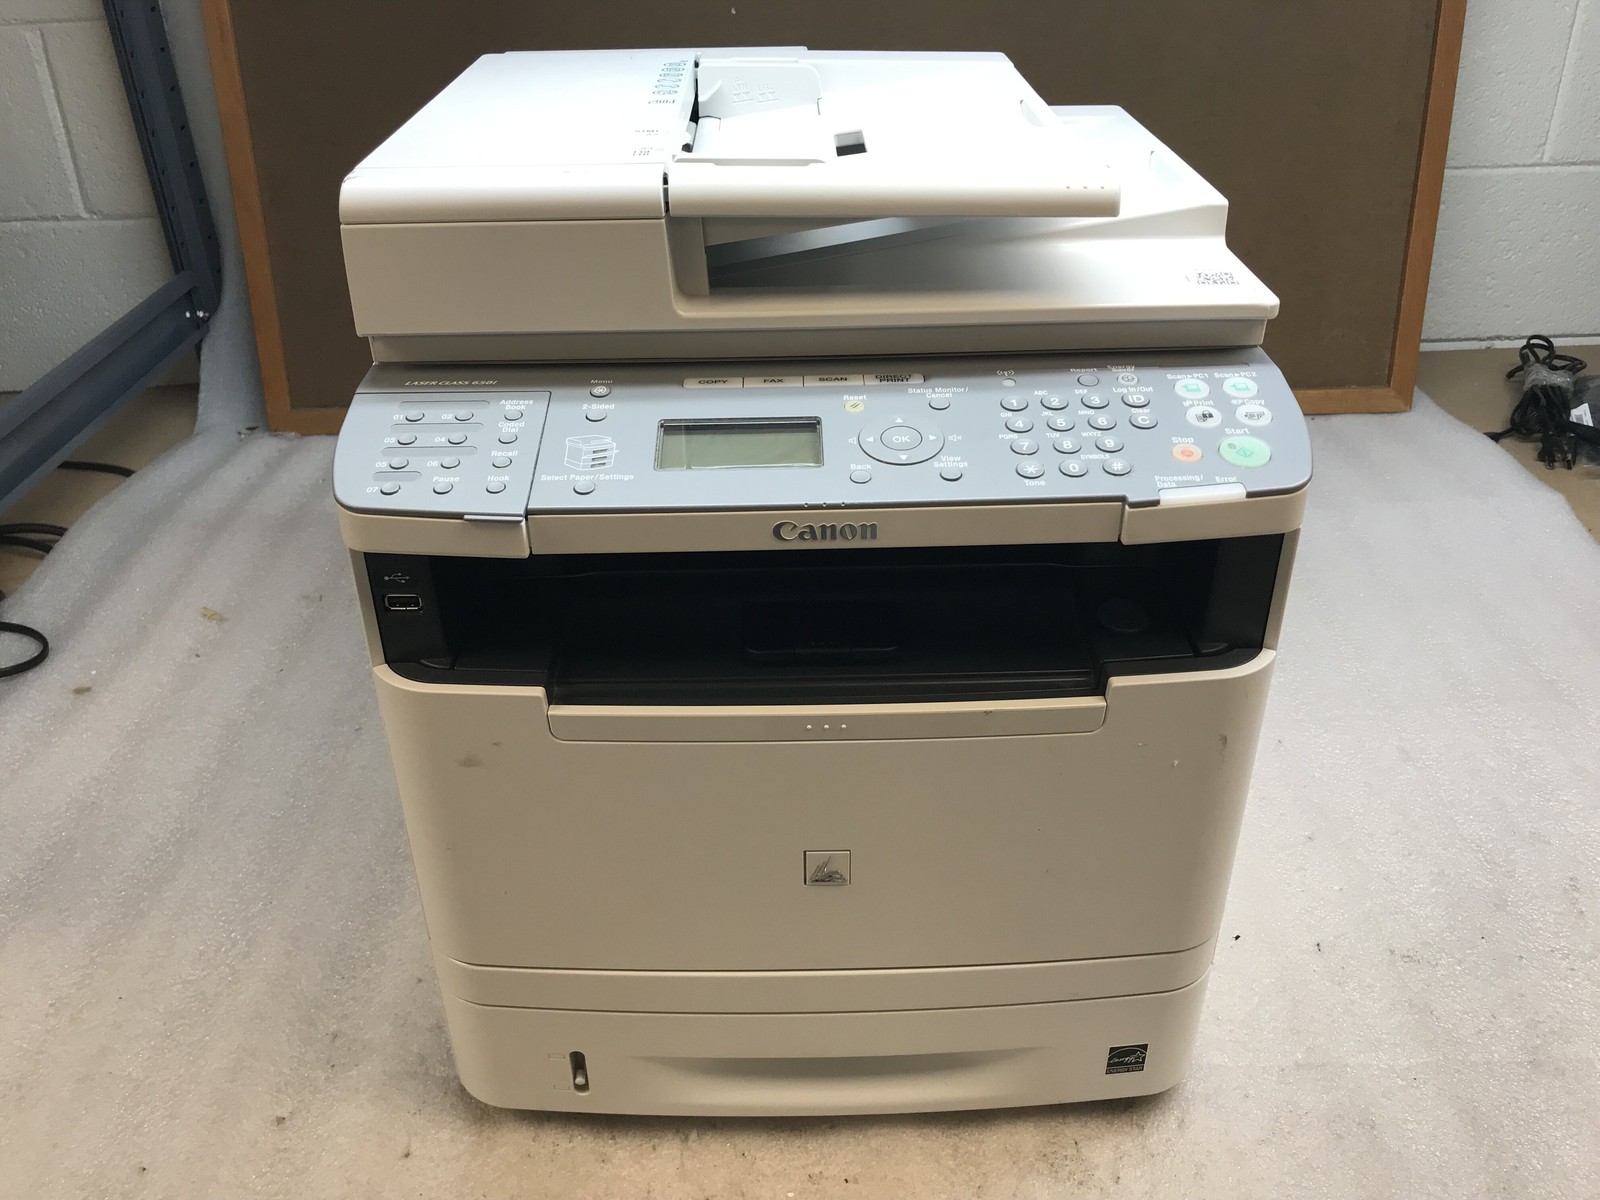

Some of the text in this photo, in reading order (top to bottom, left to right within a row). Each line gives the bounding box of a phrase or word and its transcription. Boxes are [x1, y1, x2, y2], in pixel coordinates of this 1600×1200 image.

[1010, 399, 1017, 407] 1
[1050, 397, 1060, 406] 2
[1090, 396, 1100, 404] 3
[1128, 394, 1145, 403] ID
[1014, 420, 1024, 428] 4
[1056, 418, 1066, 427] 5
[1097, 417, 1108, 426] 6
[1138, 415, 1150, 424] C
[1224, 427, 1250, 435] Start
[892, 435, 911, 443] OK
[1104, 439, 1114, 448] 9
[1171, 436, 1195, 444] Stop
[1020, 442, 1029, 450] 7
[1062, 440, 1073, 449] 8
[1069, 463, 1079, 472] 0
[569, 473, 634, 482] Paper/Settings
[1215, 476, 1238, 484] Error
[772, 520, 878, 542] Canon
